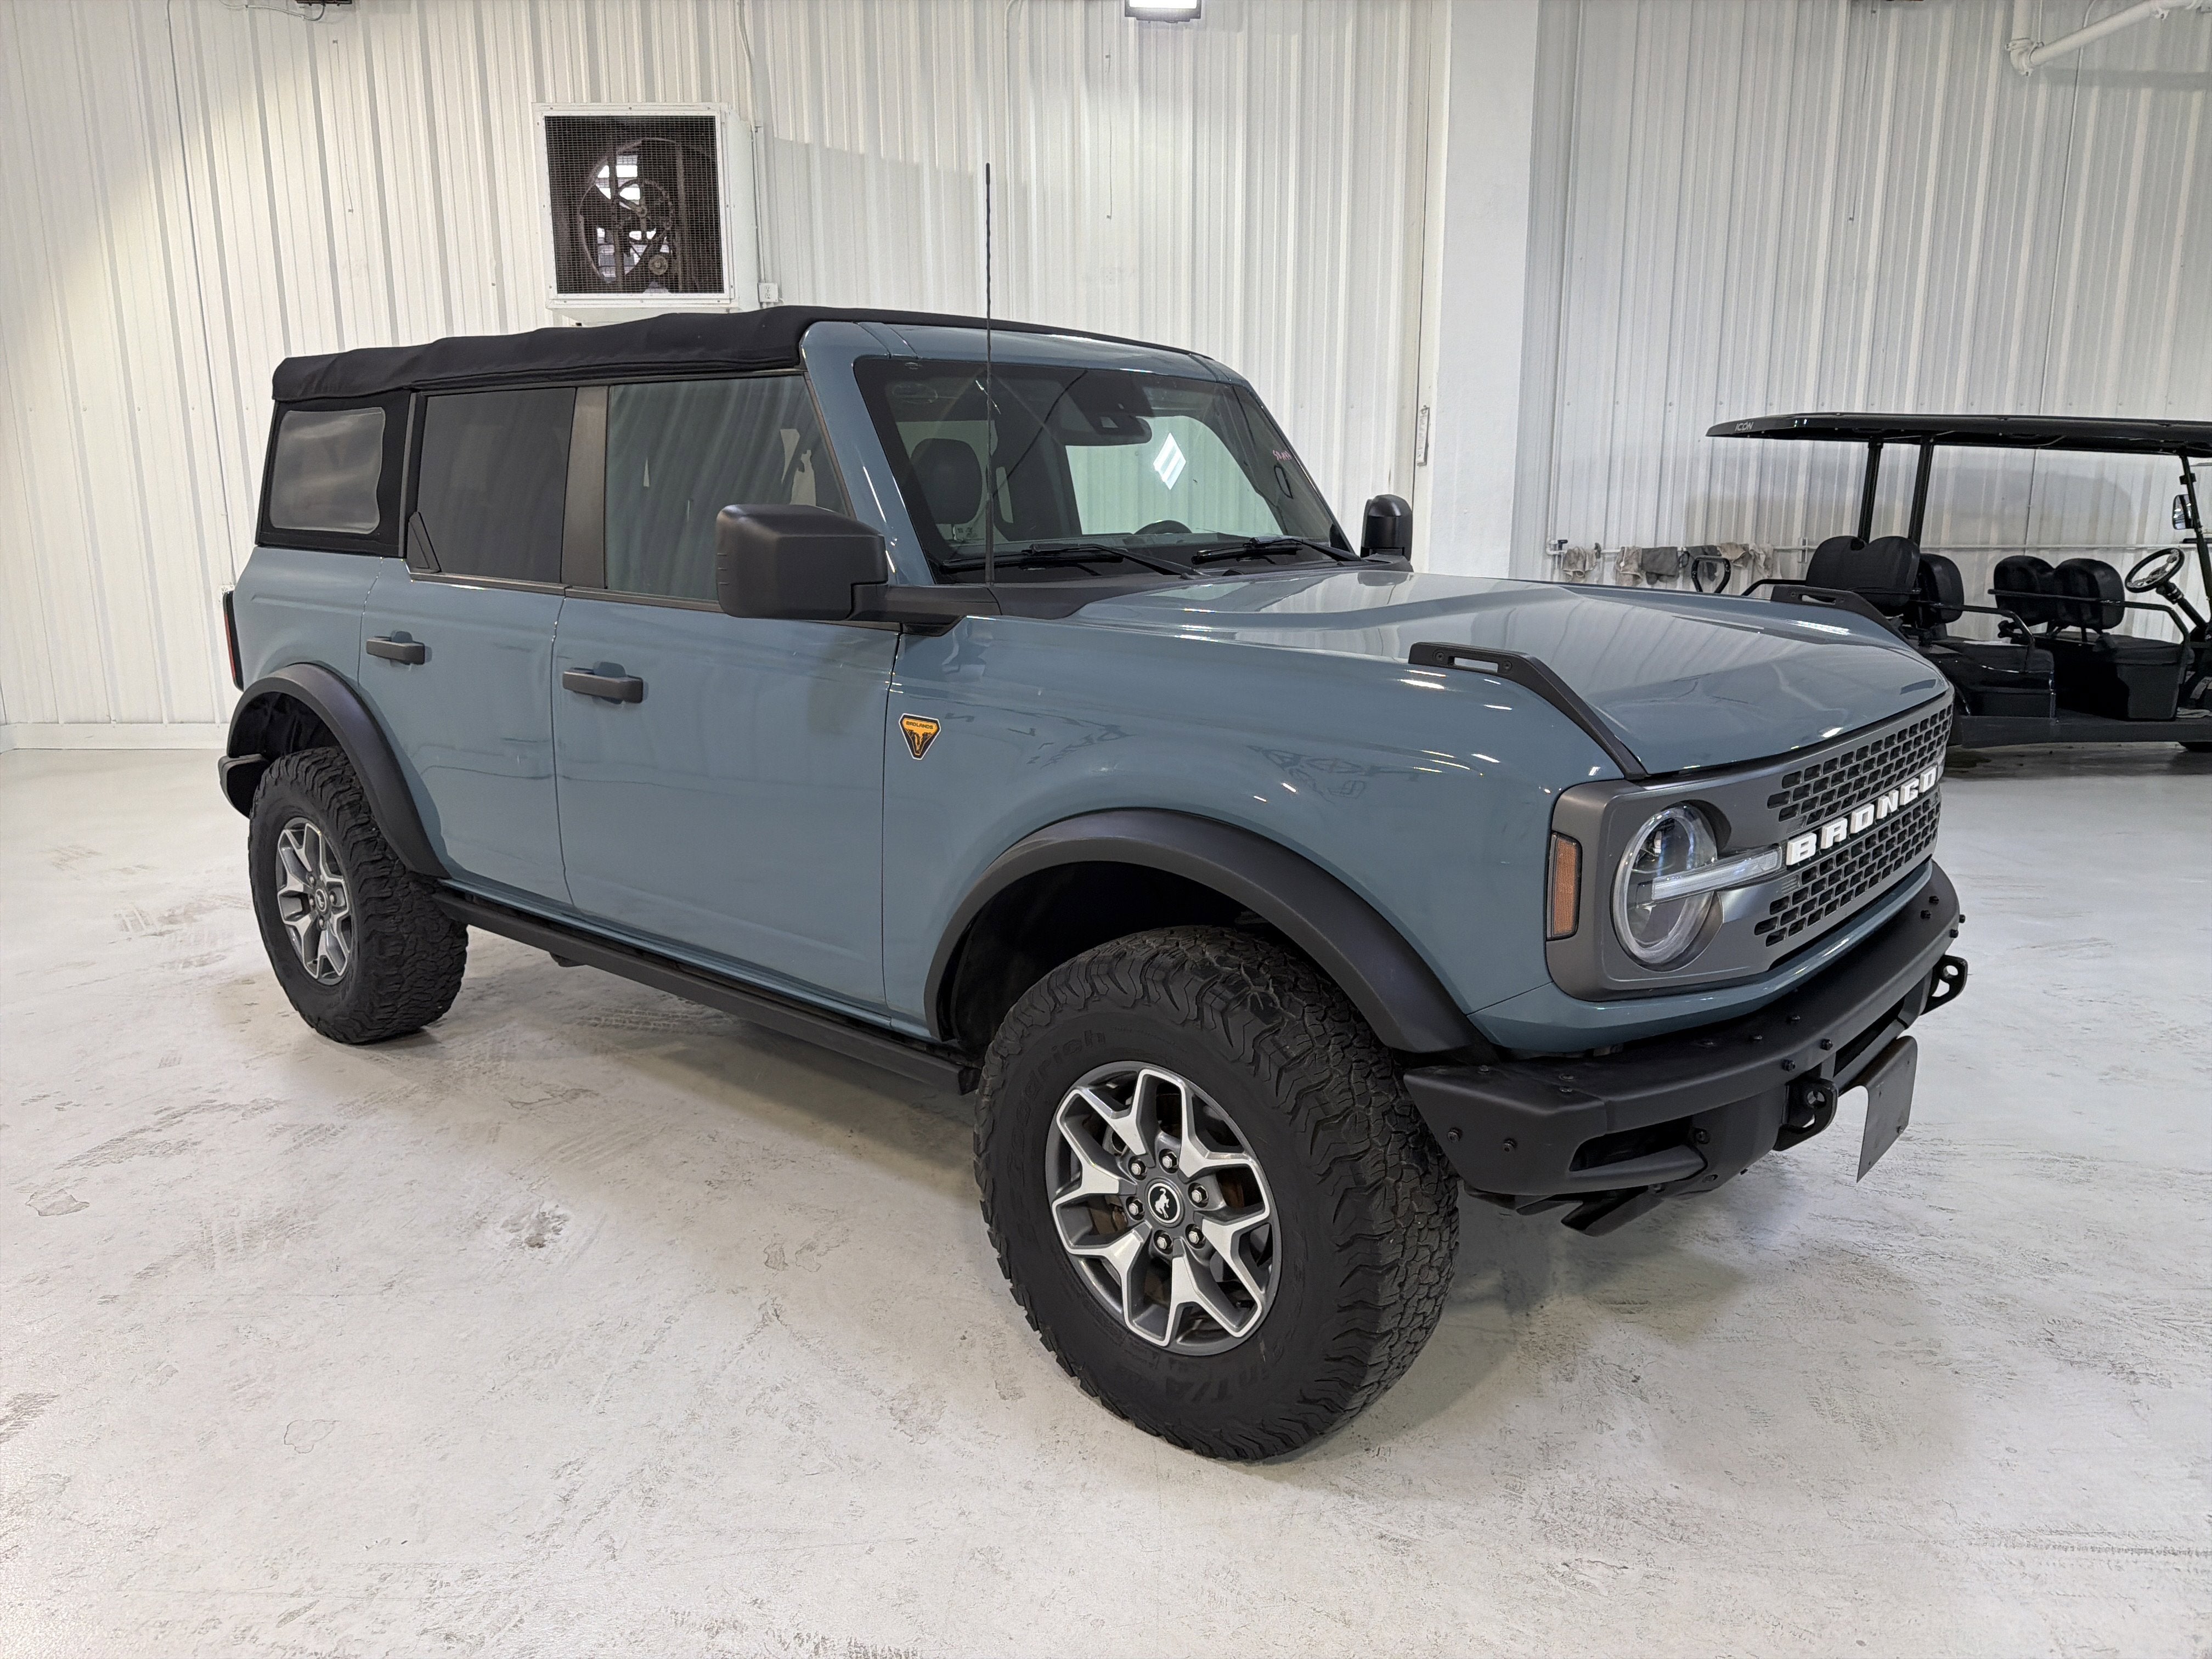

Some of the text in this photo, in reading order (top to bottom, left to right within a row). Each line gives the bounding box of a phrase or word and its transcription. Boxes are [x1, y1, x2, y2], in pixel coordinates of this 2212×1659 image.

[1734, 421, 1754, 432] ICON
[906, 721, 934, 729] BADLANDS
[1786, 767, 1937, 866] BRONCO
